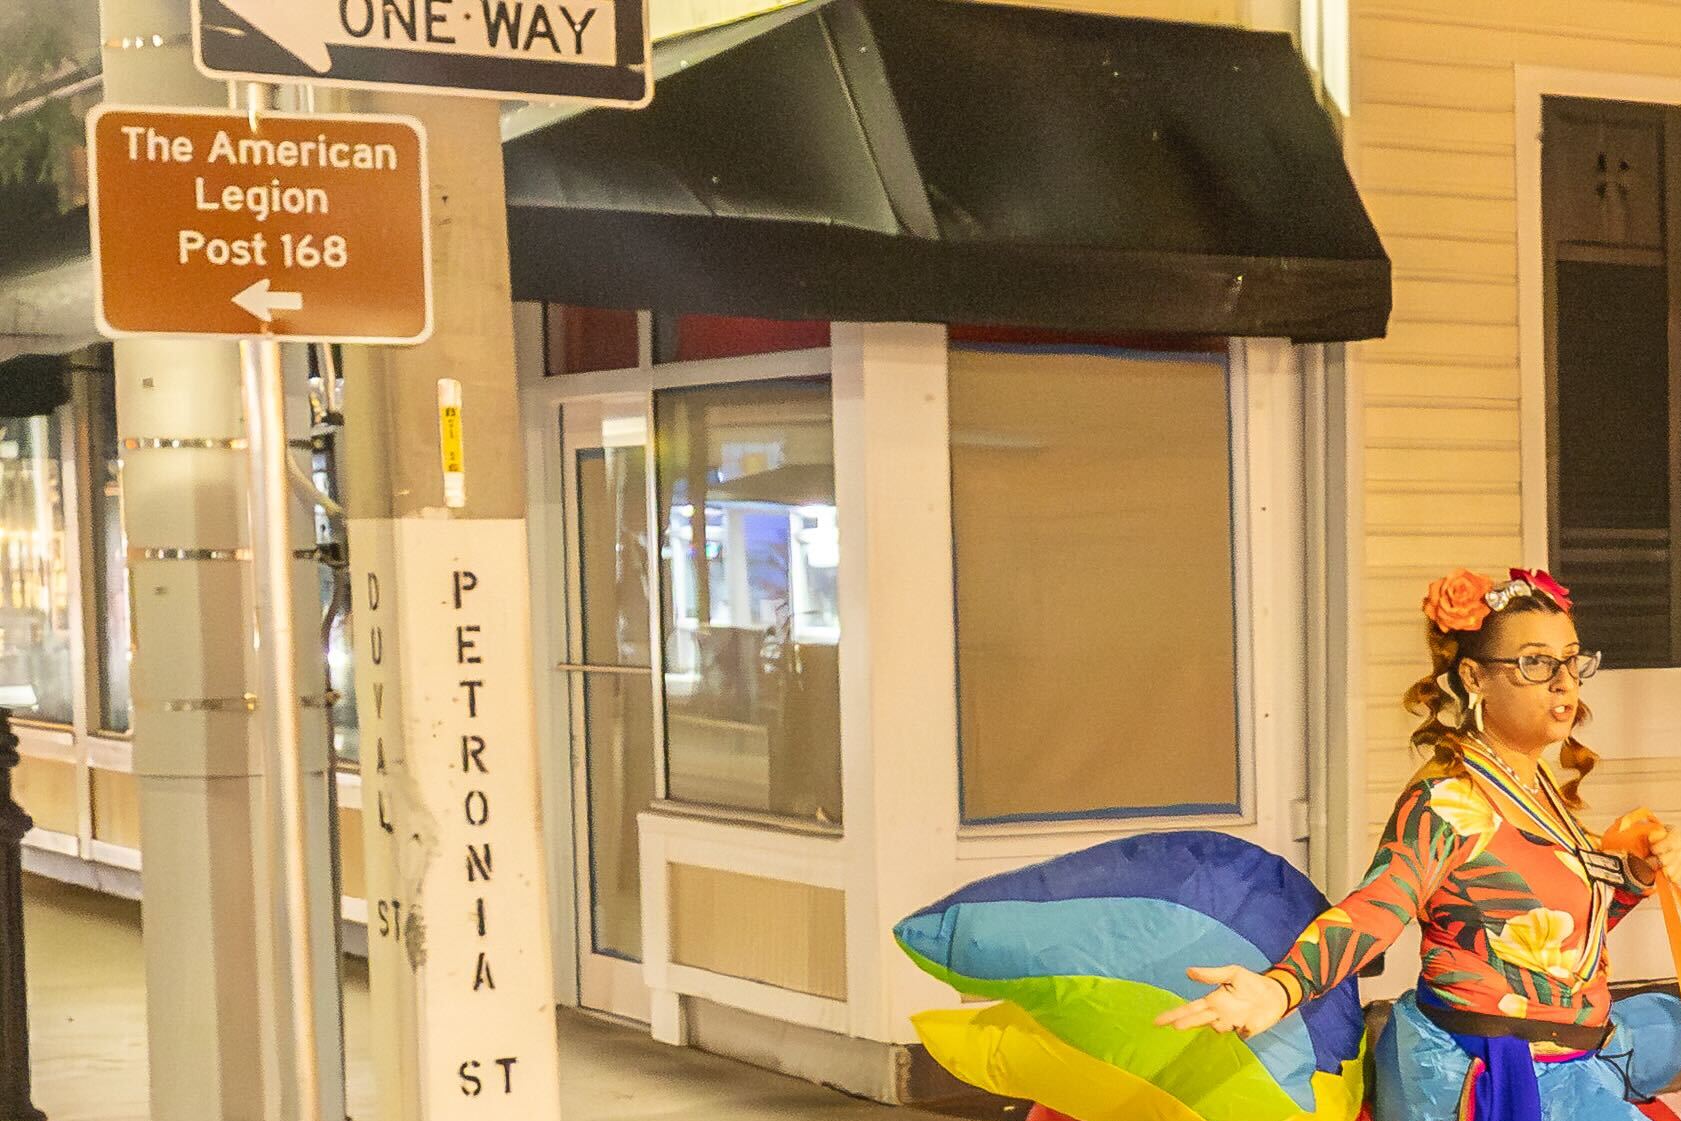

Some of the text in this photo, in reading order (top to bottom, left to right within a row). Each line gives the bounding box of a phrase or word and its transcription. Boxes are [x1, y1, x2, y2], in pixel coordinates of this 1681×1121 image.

[338, 0, 598, 54] ONE WAY
[120, 126, 398, 170] The American
[195, 176, 329, 222] Legion
[178, 230, 348, 268] Post 168
[368, 572, 401, 942] DUVAL ST
[453, 570, 518, 1097] PETRONIA ST
